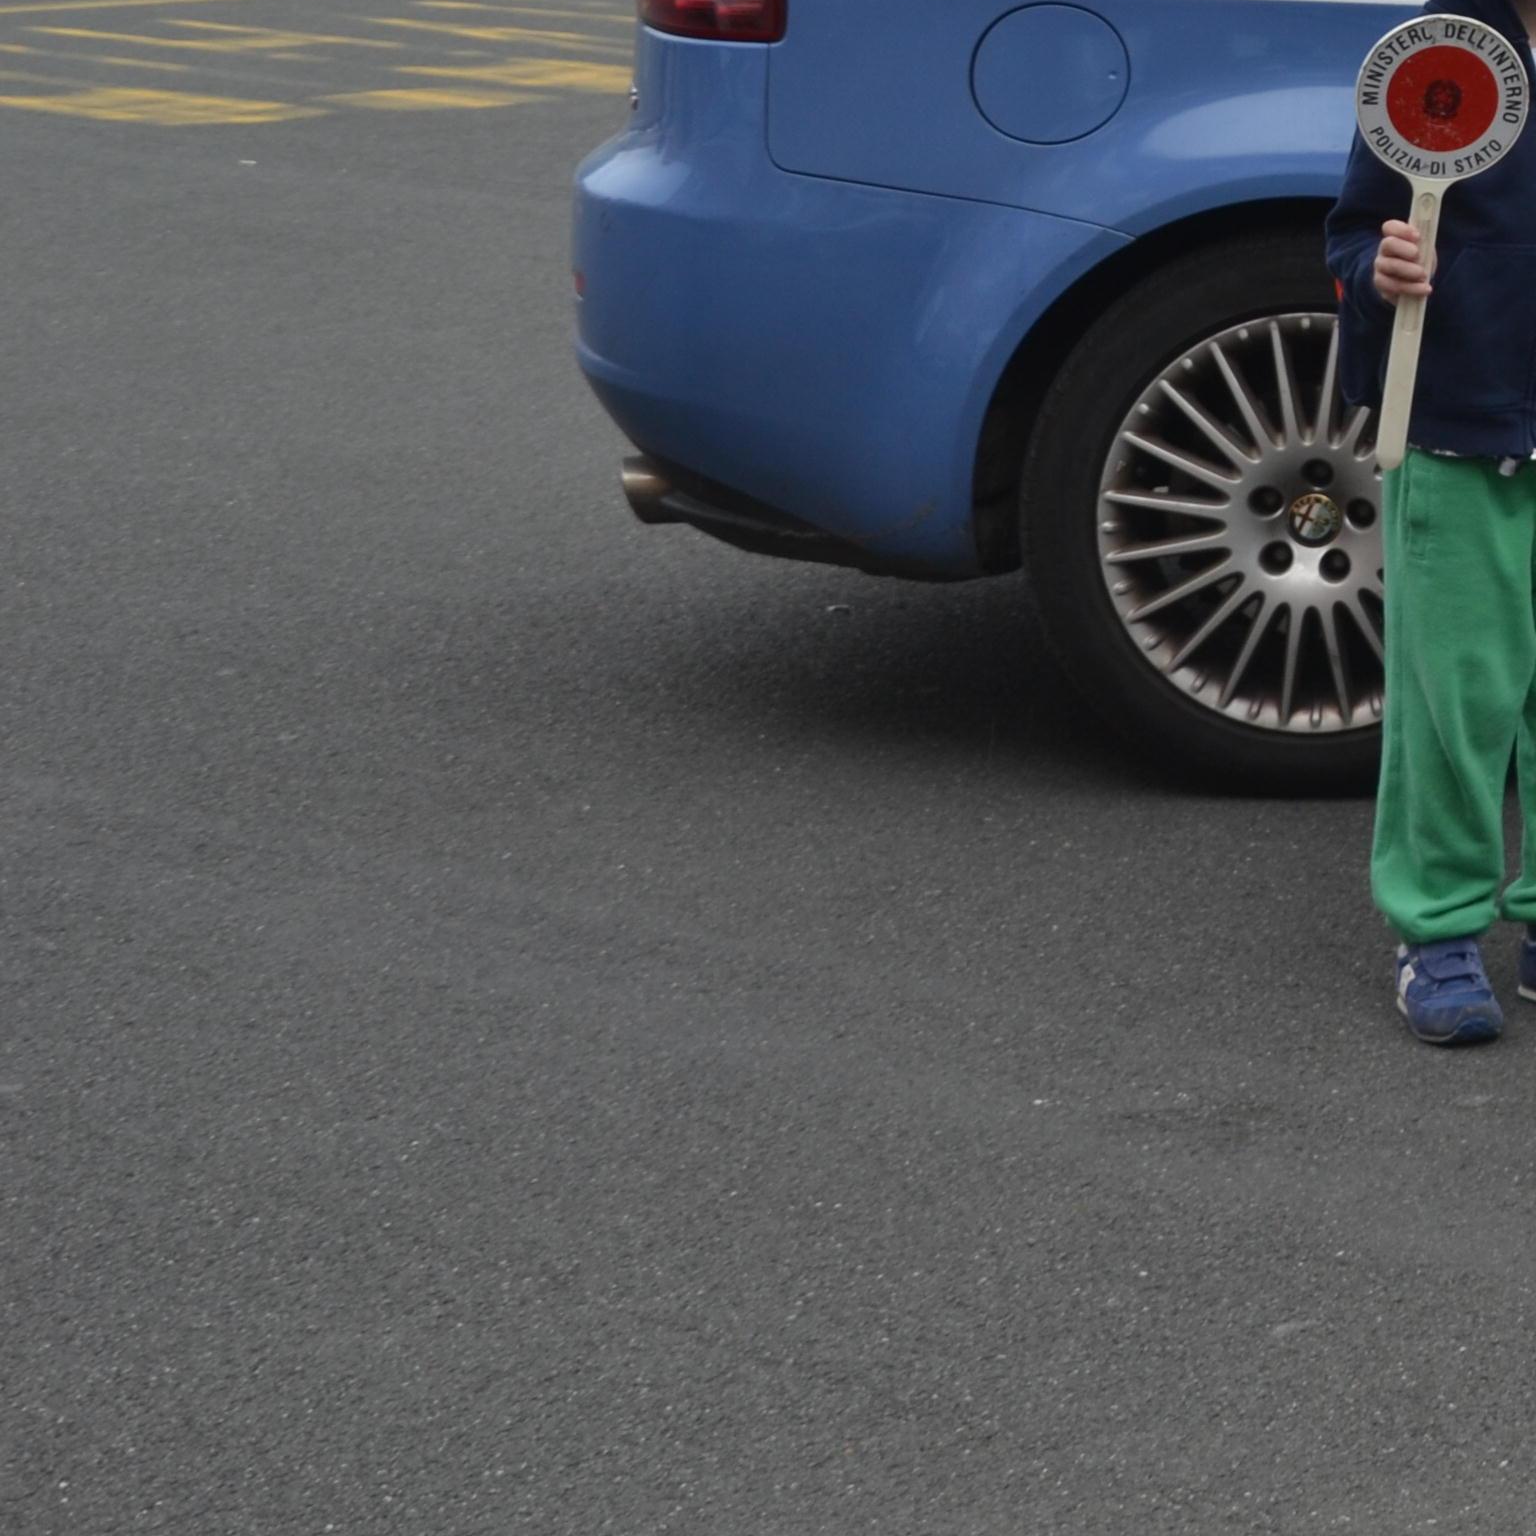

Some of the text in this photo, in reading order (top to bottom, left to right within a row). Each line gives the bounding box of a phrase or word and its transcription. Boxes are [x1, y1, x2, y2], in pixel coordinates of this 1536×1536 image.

[1444, 23, 1523, 125] DELL'INTERNO
[1370, 126, 1502, 175] POLIZIA DI STATO
